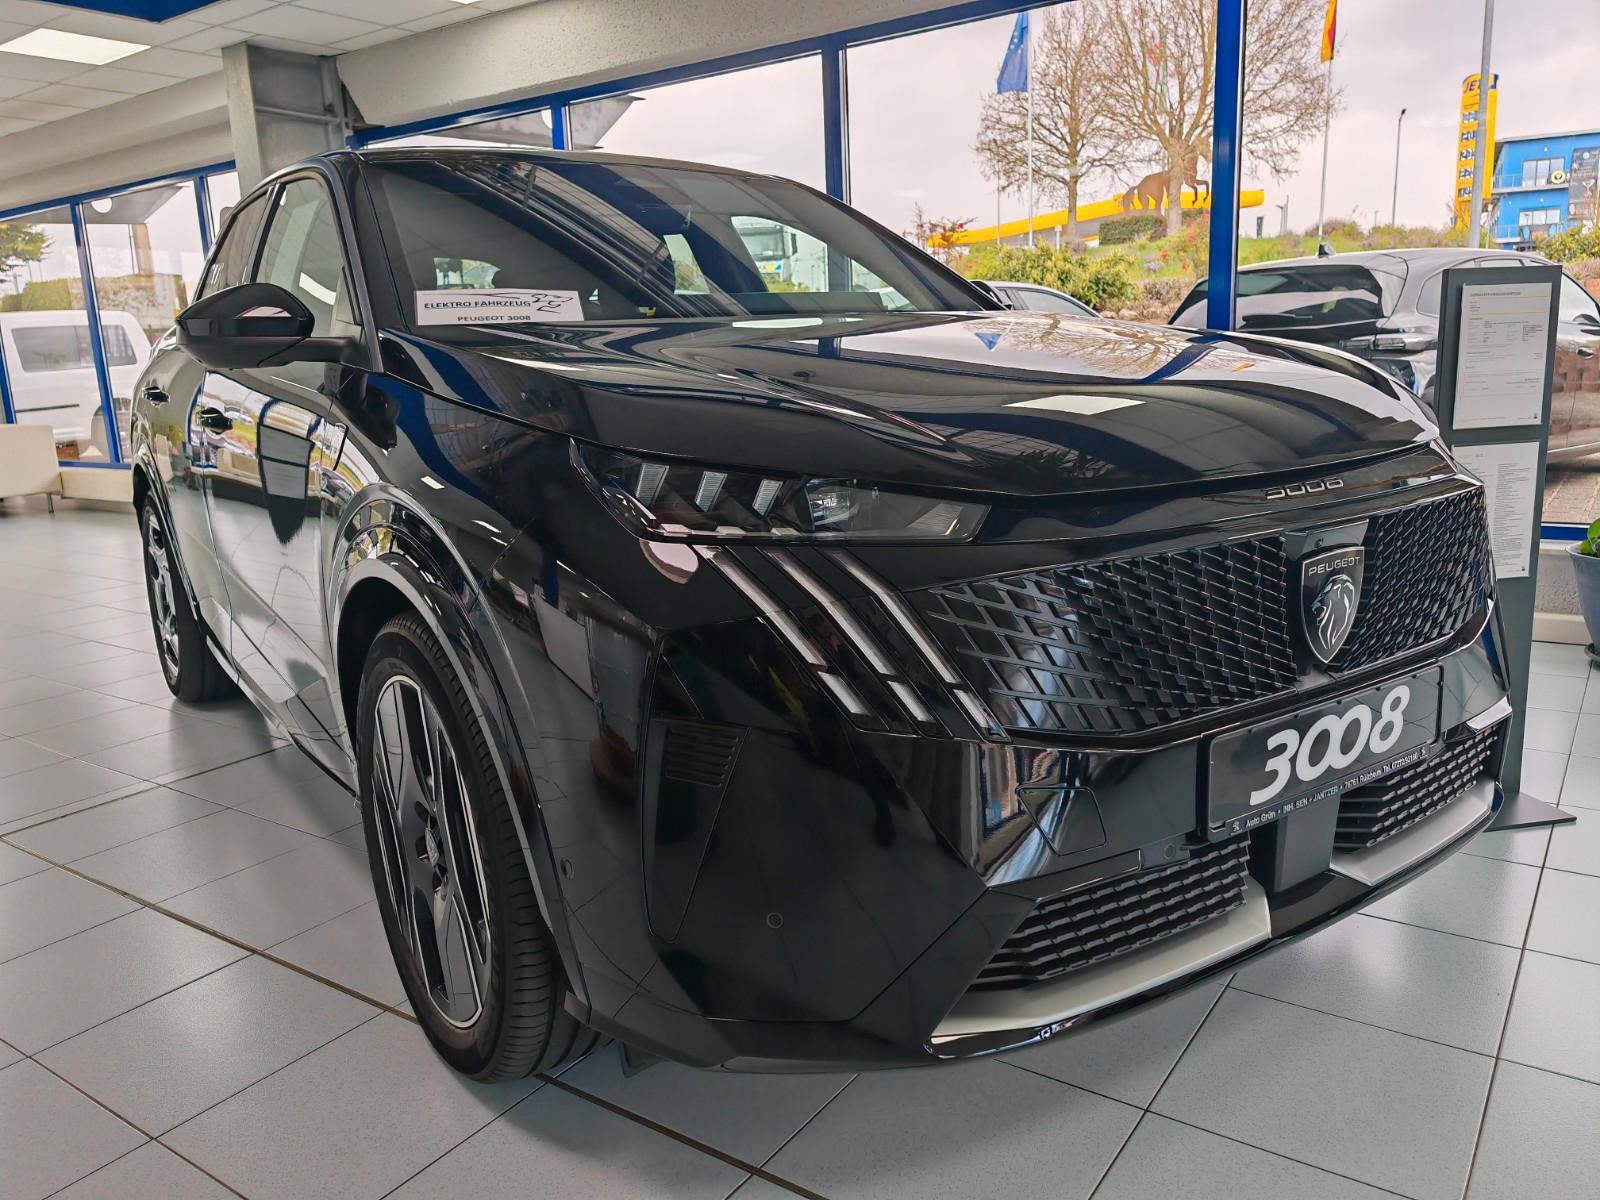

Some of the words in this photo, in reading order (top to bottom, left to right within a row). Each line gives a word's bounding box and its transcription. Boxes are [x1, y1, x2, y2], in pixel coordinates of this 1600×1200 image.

[424, 301, 472, 309] ELEKTRO
[474, 300, 532, 308] FAHRZEUG
[1308, 556, 1361, 577] PEUGEOT
[1250, 685, 1410, 806] 3008
[1245, 816, 1260, 829] Auto
[1261, 810, 1276, 824] Grün
